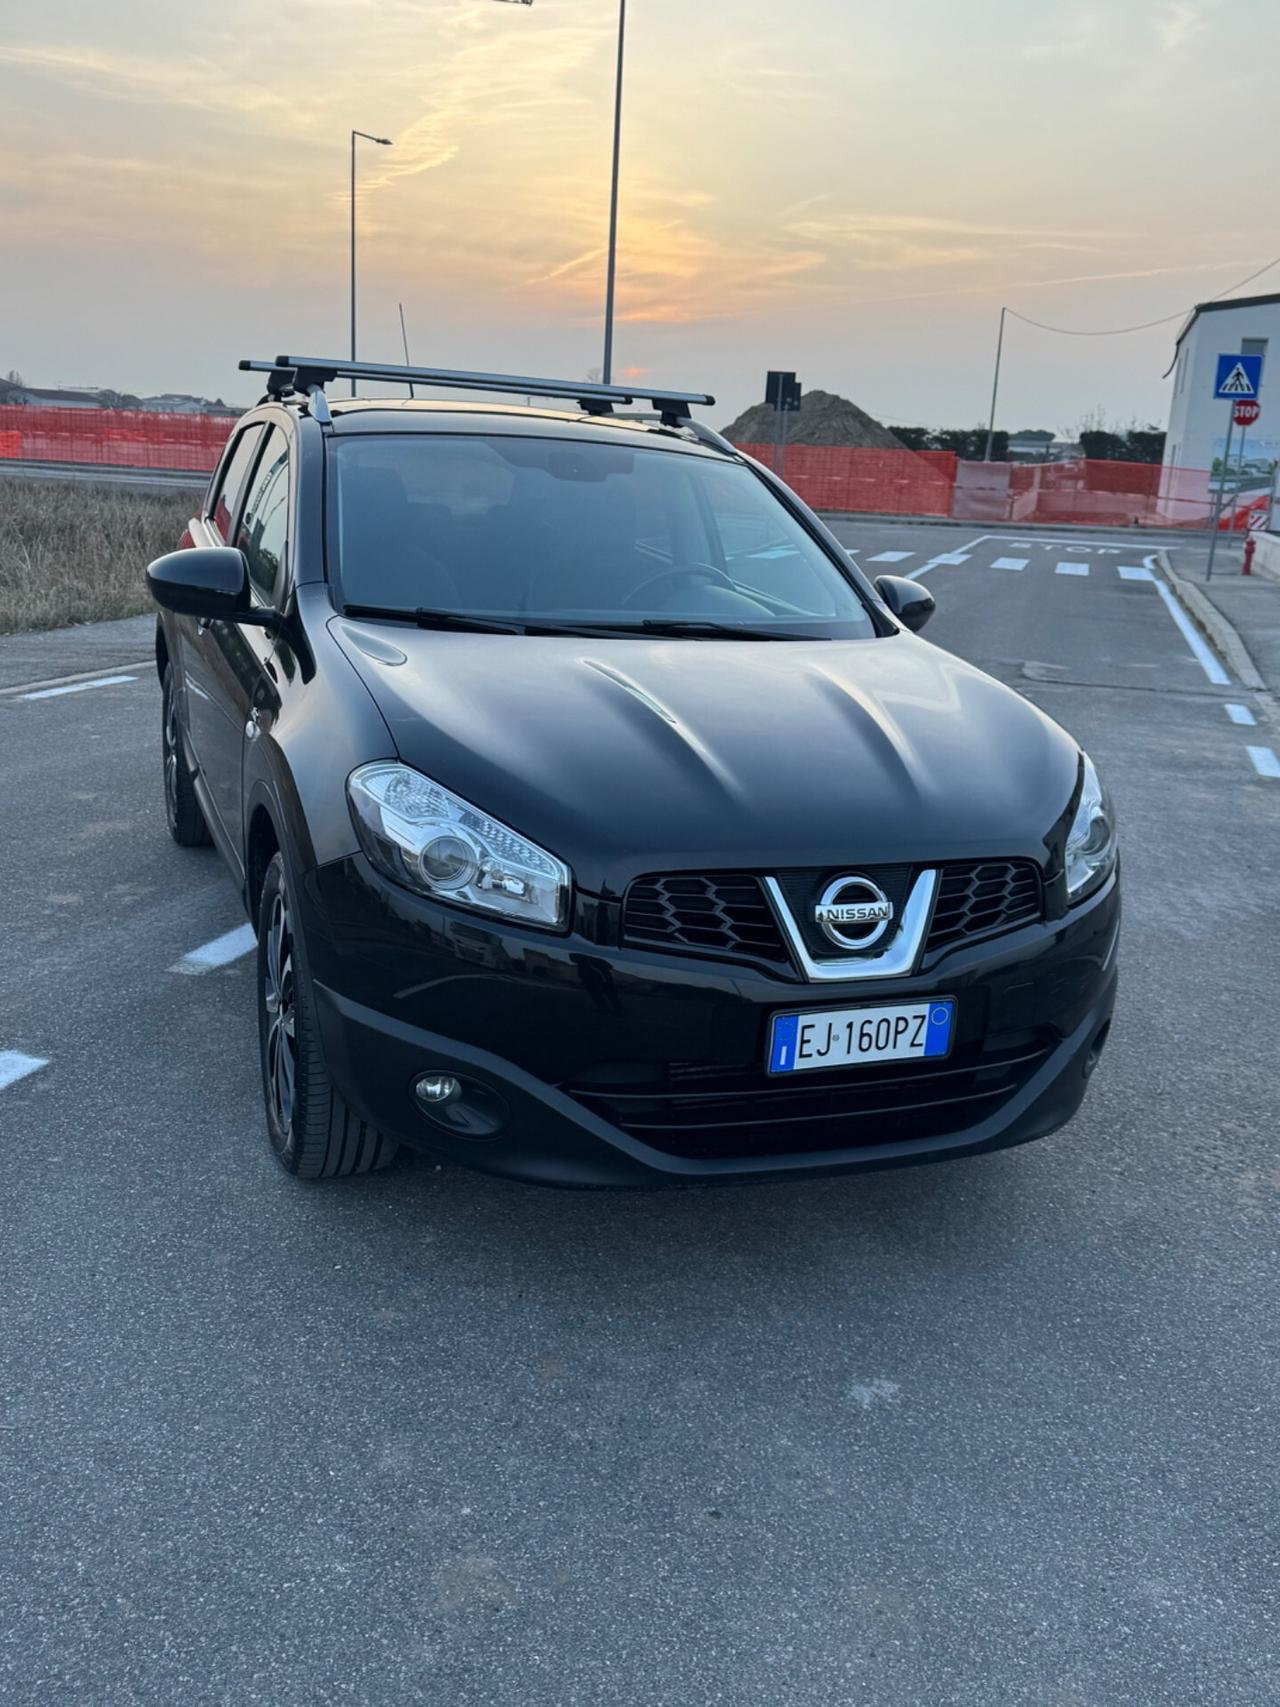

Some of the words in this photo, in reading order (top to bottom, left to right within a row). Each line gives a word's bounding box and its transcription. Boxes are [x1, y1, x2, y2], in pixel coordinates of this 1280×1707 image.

[1233, 405, 1260, 419] STOP
[1009, 541, 1122, 555] STOP
[826, 906, 888, 920] NISSAN
